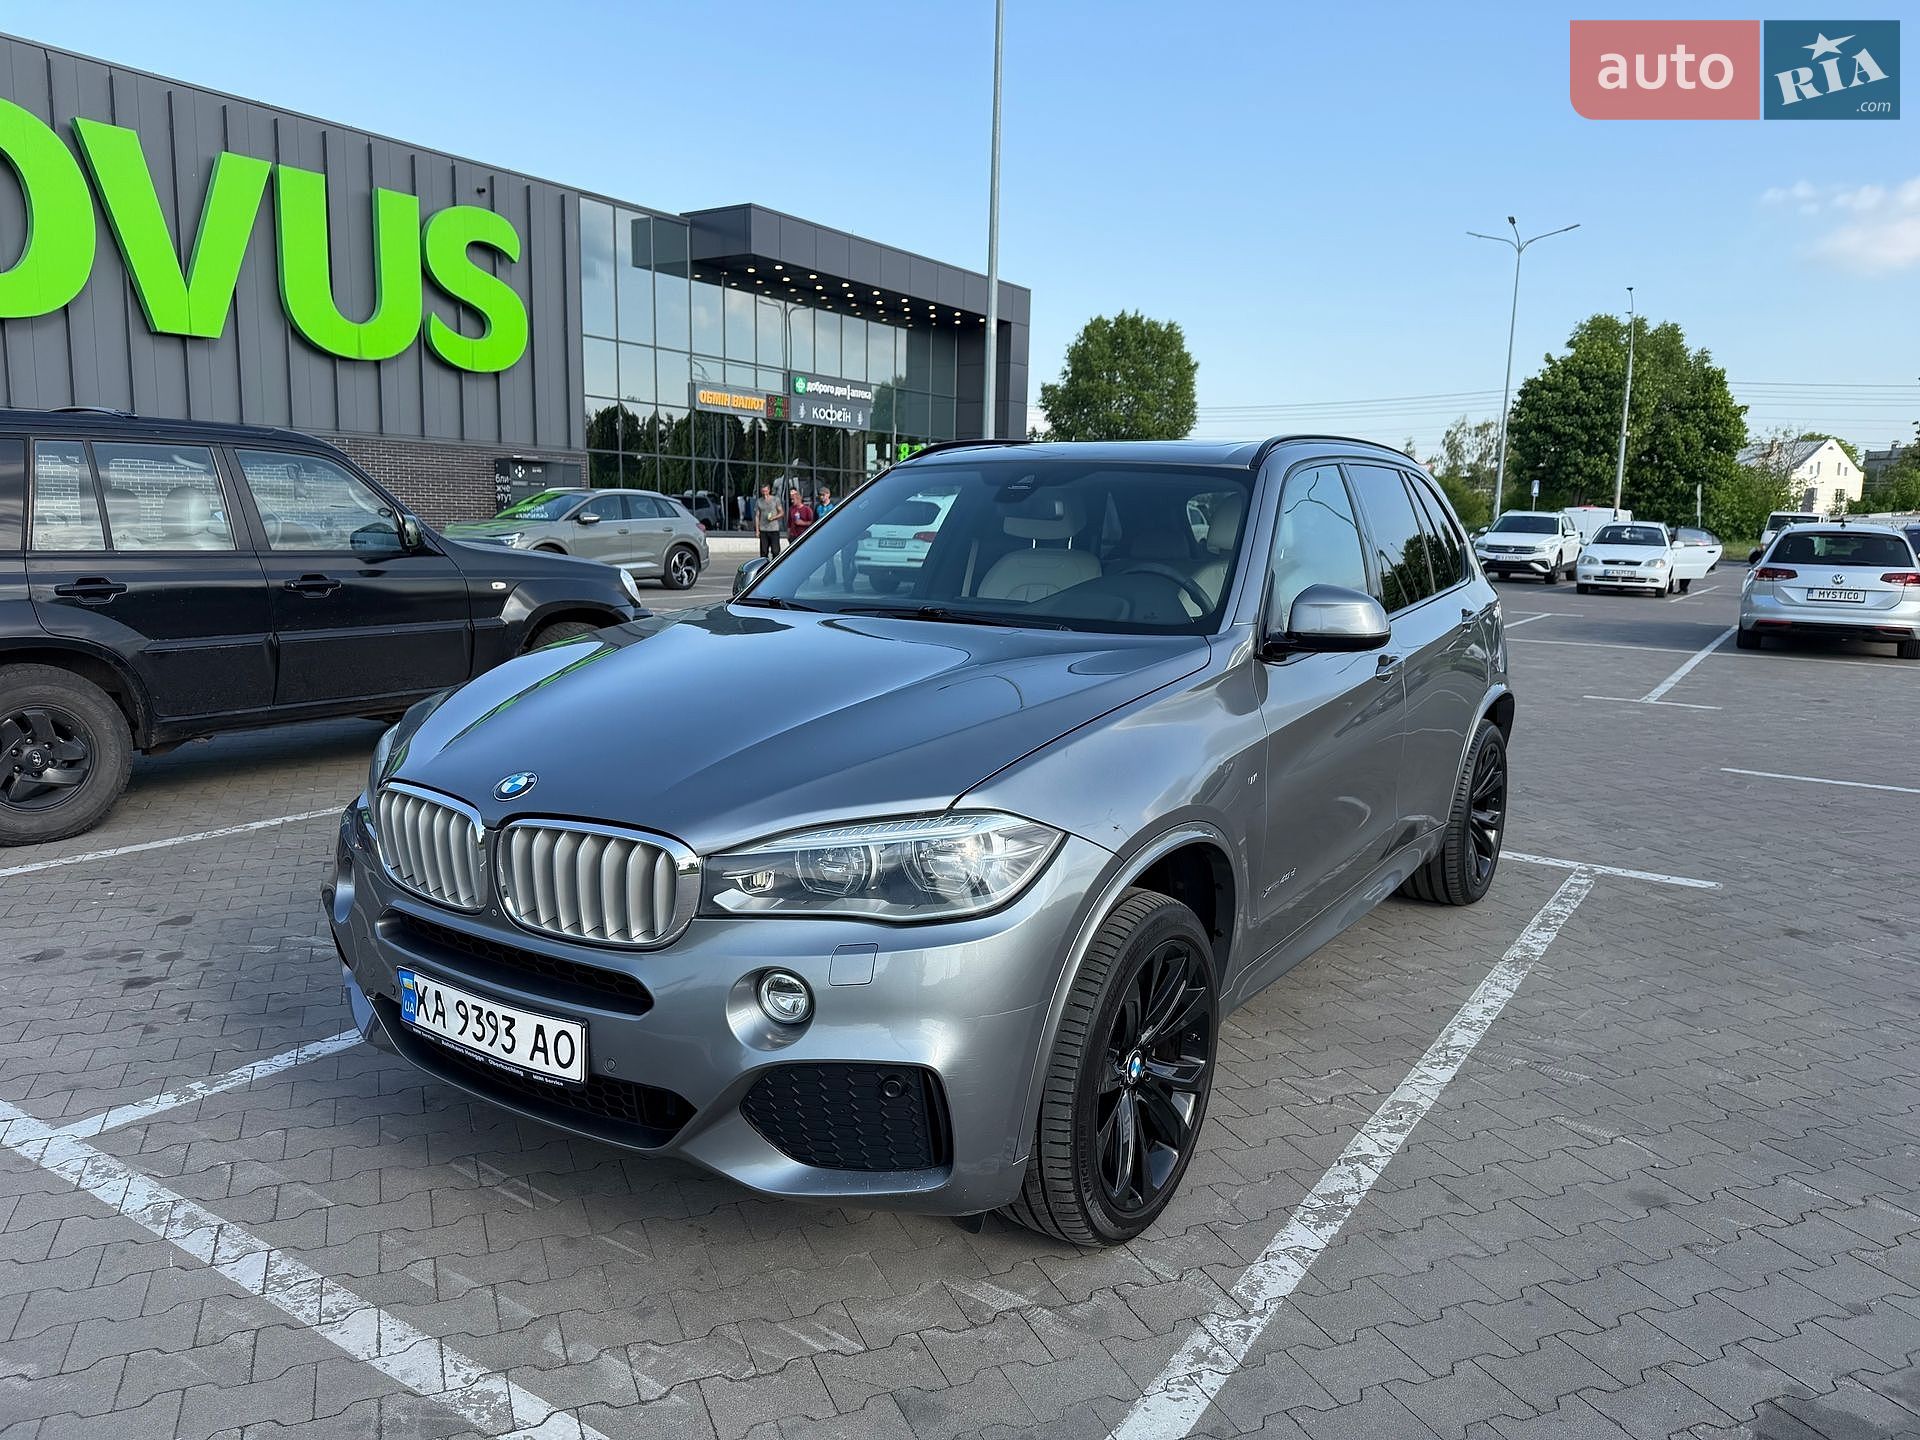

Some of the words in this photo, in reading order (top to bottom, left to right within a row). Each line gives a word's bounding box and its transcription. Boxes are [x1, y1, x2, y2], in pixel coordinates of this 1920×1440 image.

[806, 381, 835, 395] доброго
[850, 389, 872, 400] аптека
[698, 390, 731, 407] ОБМІН
[731, 394, 765, 411] ВАЛЮТ
[1818, 590, 1859, 600] MYSTICO
[404, 1000, 415, 1014] UA
[415, 980, 447, 1030] KA
[455, 999, 517, 1055] 9393
[529, 1023, 576, 1070] AO
